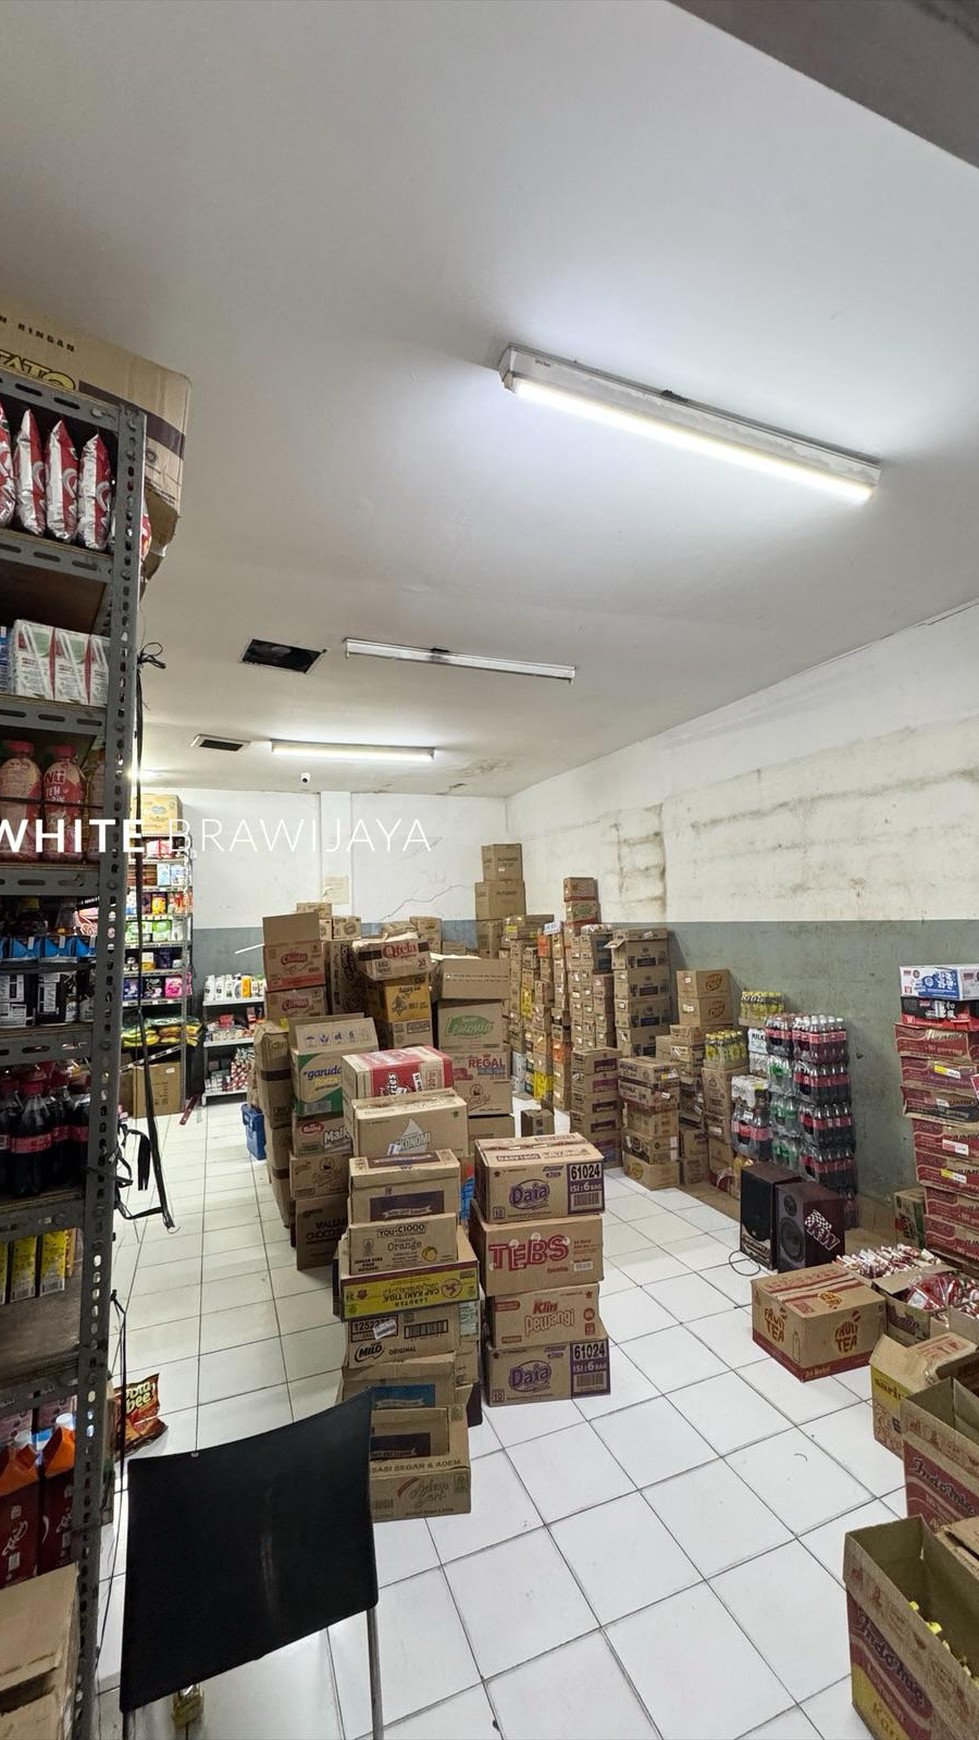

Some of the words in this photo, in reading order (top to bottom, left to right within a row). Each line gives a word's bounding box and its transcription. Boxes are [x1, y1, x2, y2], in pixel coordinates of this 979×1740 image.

[17, 322, 75, 353] RINGAN
[468, 1057, 504, 1069] REGAL
[571, 1163, 601, 1180] 61024
[510, 1180, 551, 1204] Daia
[387, 1241, 422, 1252] Orange
[488, 1234, 570, 1272] TEBS
[532, 1299, 559, 1315] Klin
[764, 1307, 785, 1328] FRUIT
[765, 1318, 785, 1343] TEA
[834, 1321, 859, 1337] FRUIT
[358, 1344, 383, 1358] MILO
[574, 1343, 606, 1360] 61024
[834, 1334, 858, 1353] TEA
[509, 1362, 551, 1387] Daia
[394, 1463, 425, 1472] SEGAR
[435, 1459, 461, 1468] ADEM
